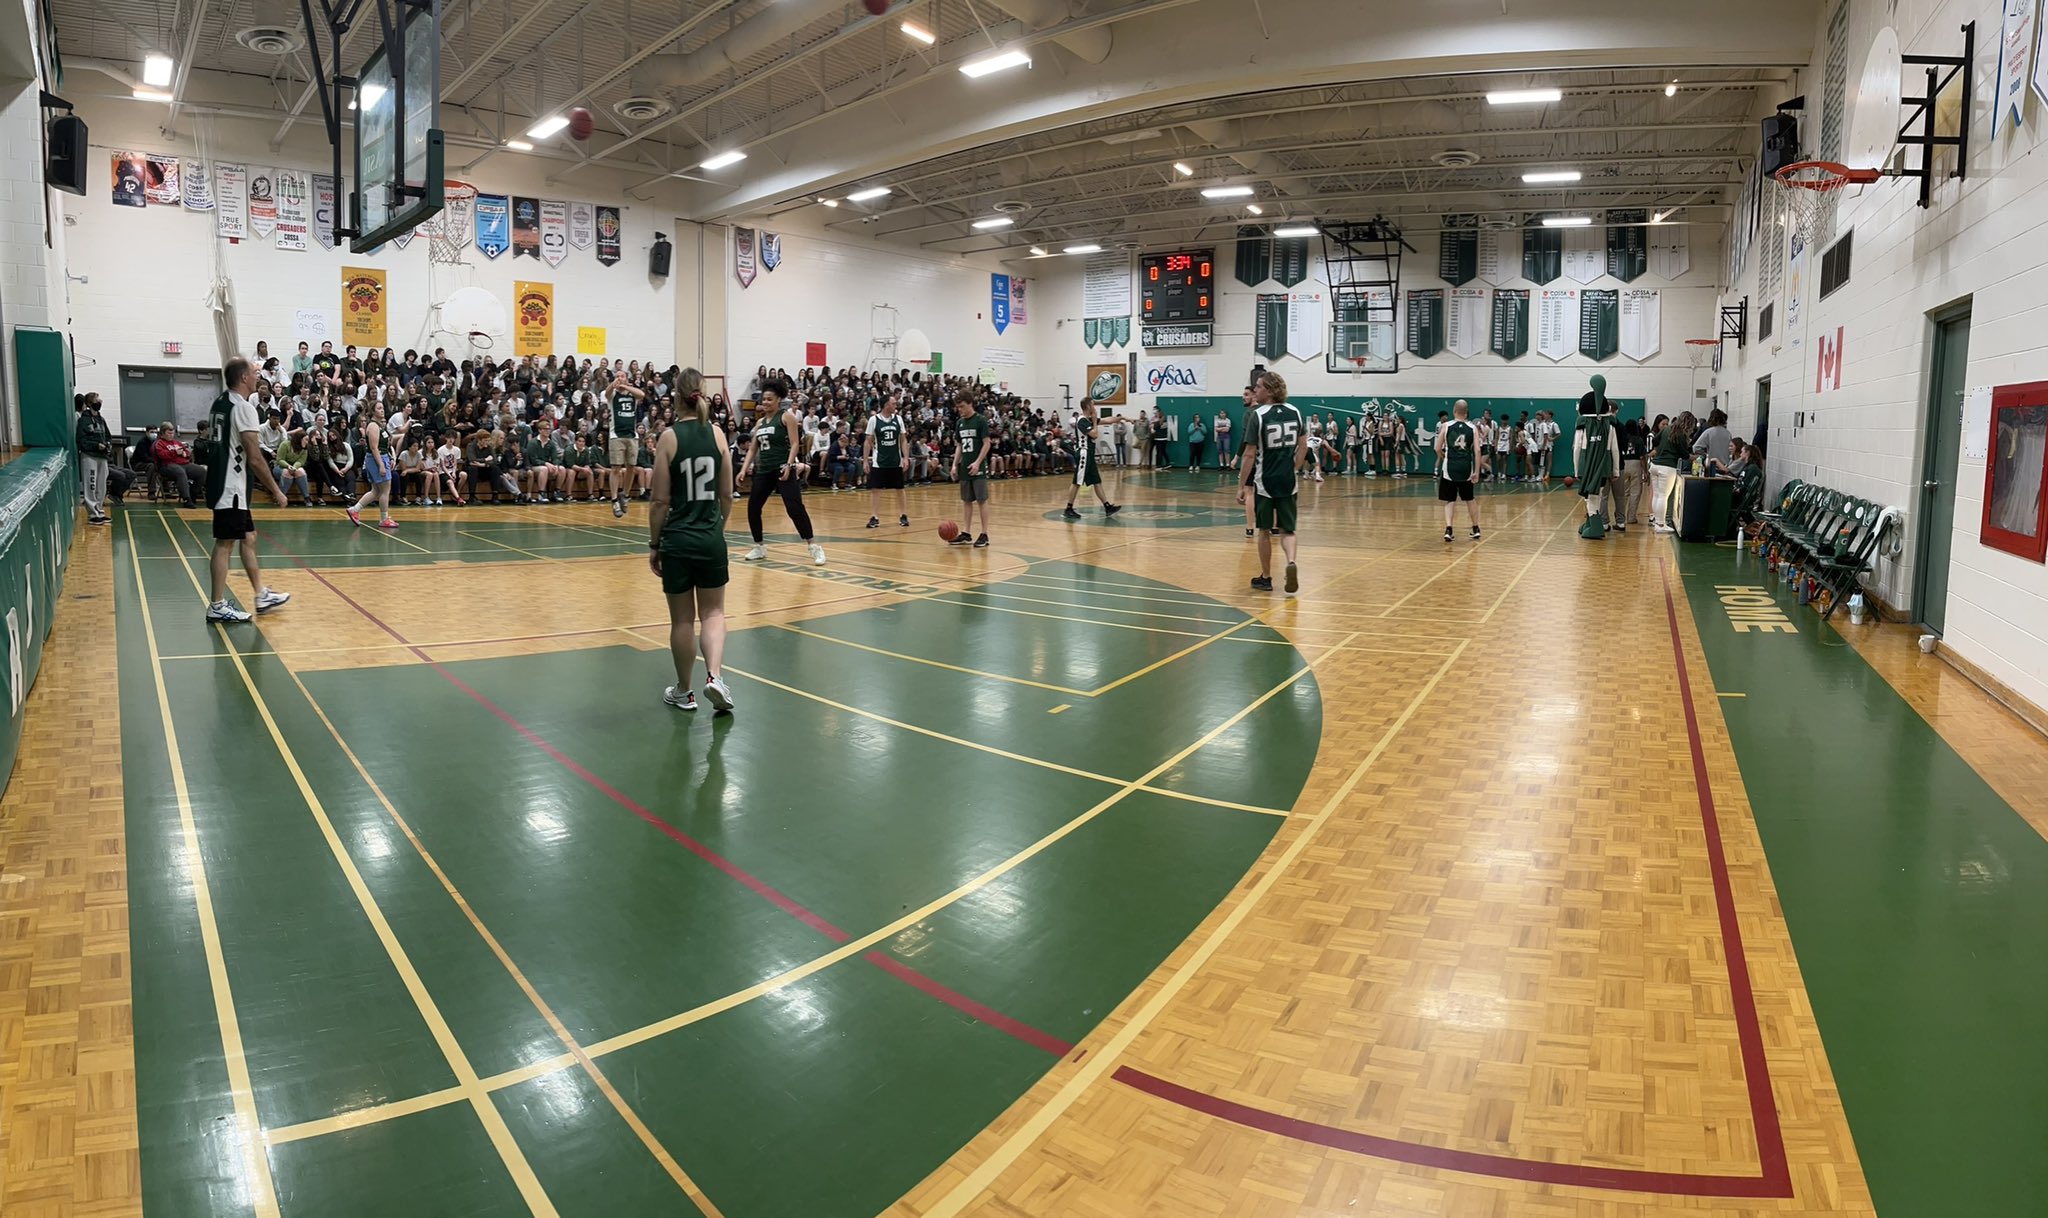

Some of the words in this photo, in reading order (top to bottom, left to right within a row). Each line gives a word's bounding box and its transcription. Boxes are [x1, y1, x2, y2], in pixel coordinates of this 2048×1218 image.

[125, 181, 136, 194] 42
[219, 222, 243, 231] SPORT
[222, 216, 240, 224] TRUE
[276, 223, 307, 233] CRUSADERS
[284, 233, 299, 241] COSSA
[1166, 255, 1191, 271] 3:34
[1201, 262, 1210, 277] 0
[1150, 266, 1159, 281] 0
[1187, 275, 1192, 285] 1
[1145, 299, 1153, 310] 0
[1200, 296, 1208, 307] 0
[997, 304, 1004, 318] 5
[1156, 332, 1209, 345] CRUSADERS
[621, 402, 632, 411] 15
[884, 431, 894, 440] 31
[1267, 421, 1298, 448] 25
[961, 437, 974, 453] 23
[1454, 434, 1467, 450] 4
[680, 456, 715, 502] 12
[1713, 585, 1799, 633] HOME
